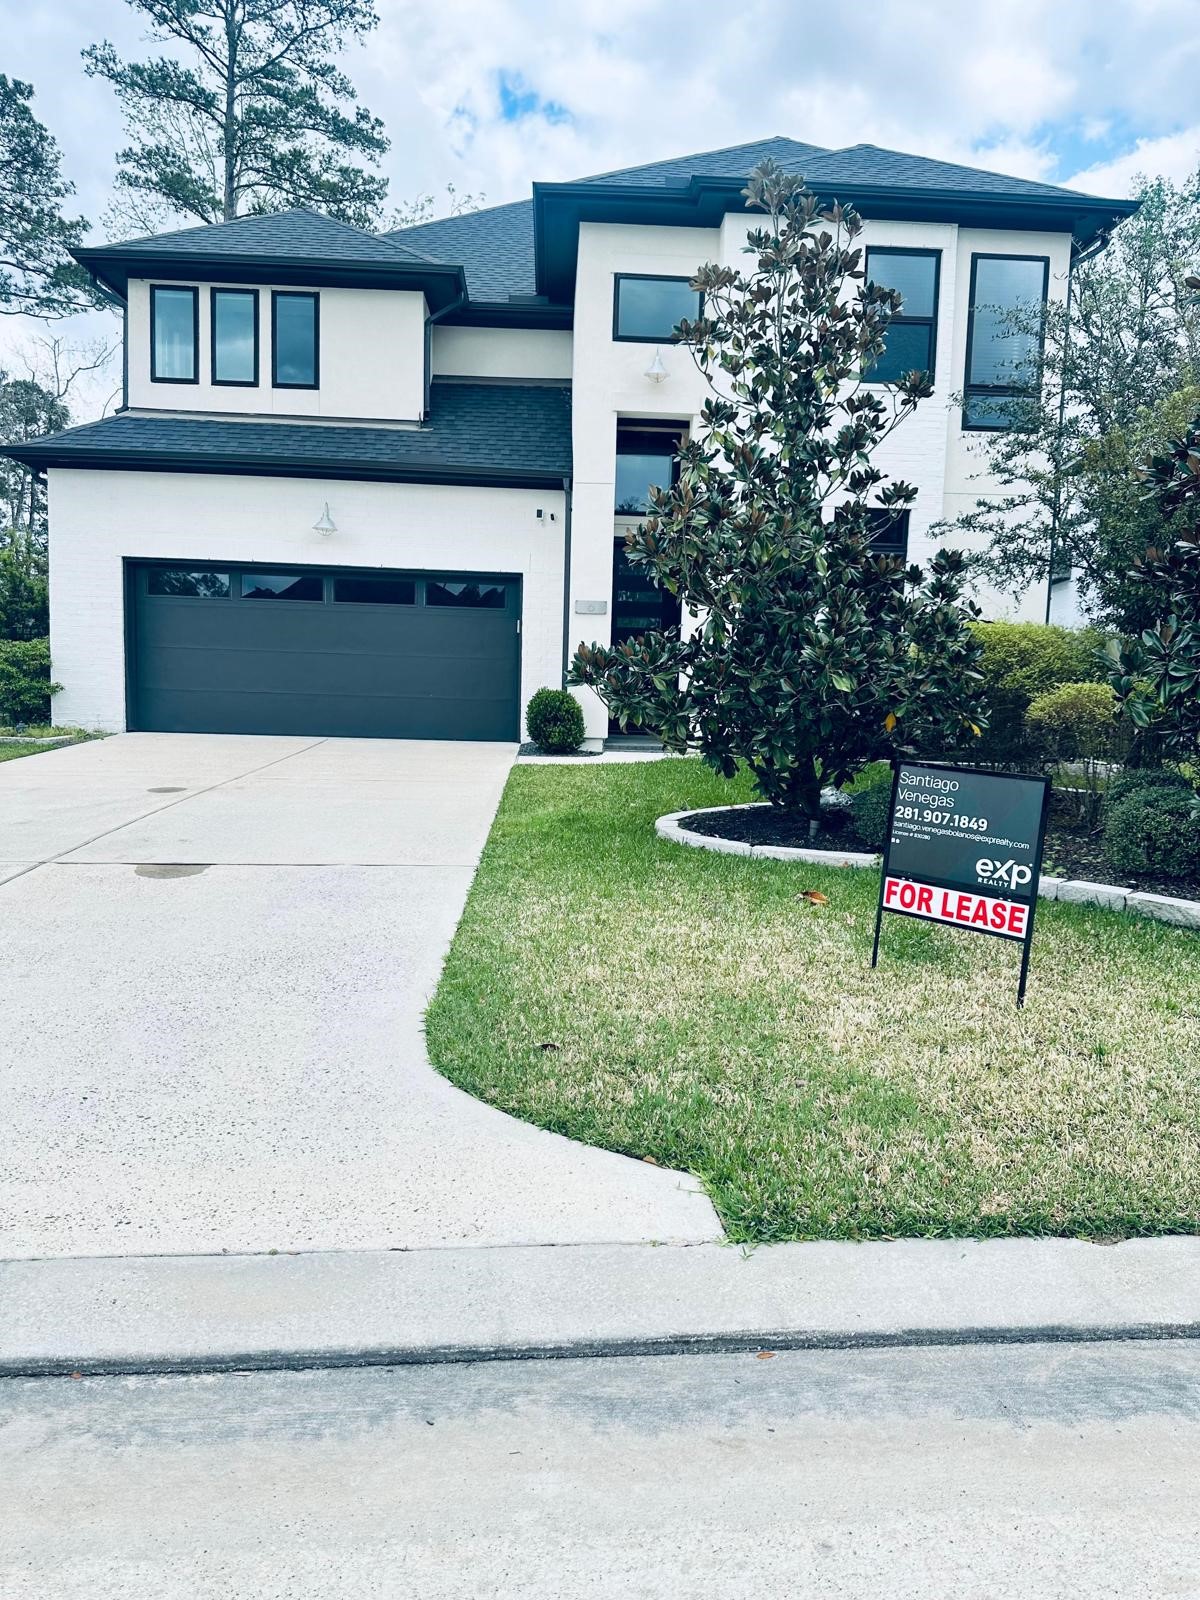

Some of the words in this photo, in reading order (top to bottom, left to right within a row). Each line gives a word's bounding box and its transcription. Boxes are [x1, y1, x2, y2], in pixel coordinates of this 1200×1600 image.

[899, 771, 959, 793] Santiago
[898, 788, 955, 807] Venegas
[895, 806, 988, 831] 281.907.1849
[977, 877, 1009, 888] REALTY
[885, 880, 933, 914] FOR
[941, 892, 1026, 934] LEASE
